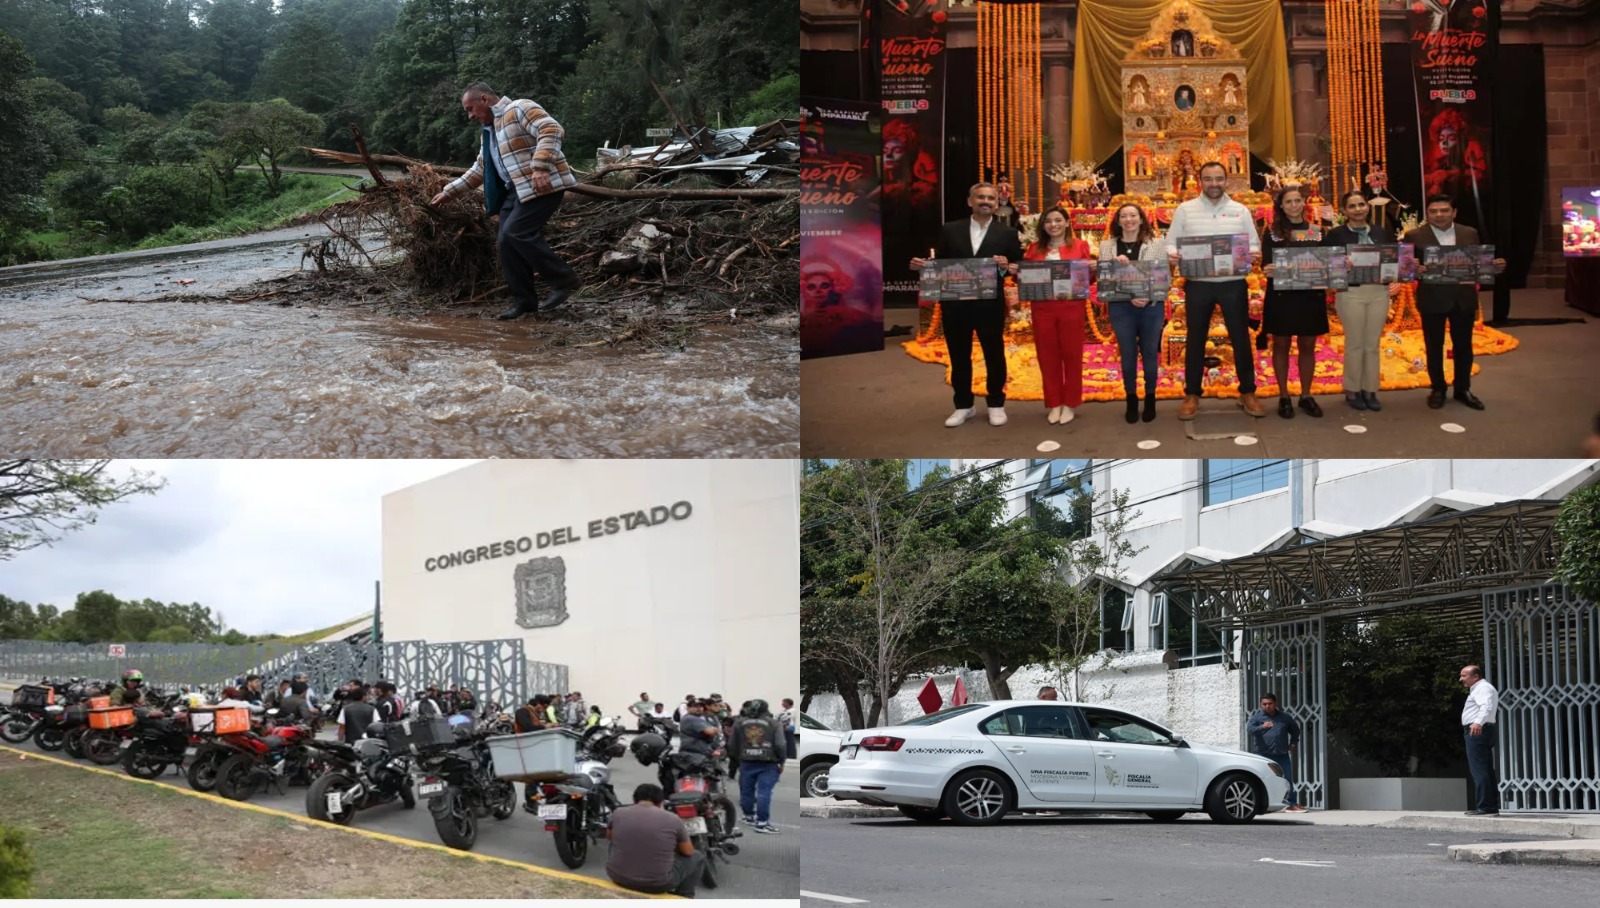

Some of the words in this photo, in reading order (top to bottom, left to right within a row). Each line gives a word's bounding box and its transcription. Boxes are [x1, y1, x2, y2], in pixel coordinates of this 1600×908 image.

[1422, 31, 1486, 50] Muerte
[800, 161, 863, 185] uerte
[800, 186, 859, 205] ueño
[800, 229, 843, 237] VIEMBRE
[424, 536, 532, 572] CONGRESO
[536, 526, 581, 550] DEL
[587, 500, 693, 539] ESTADO
